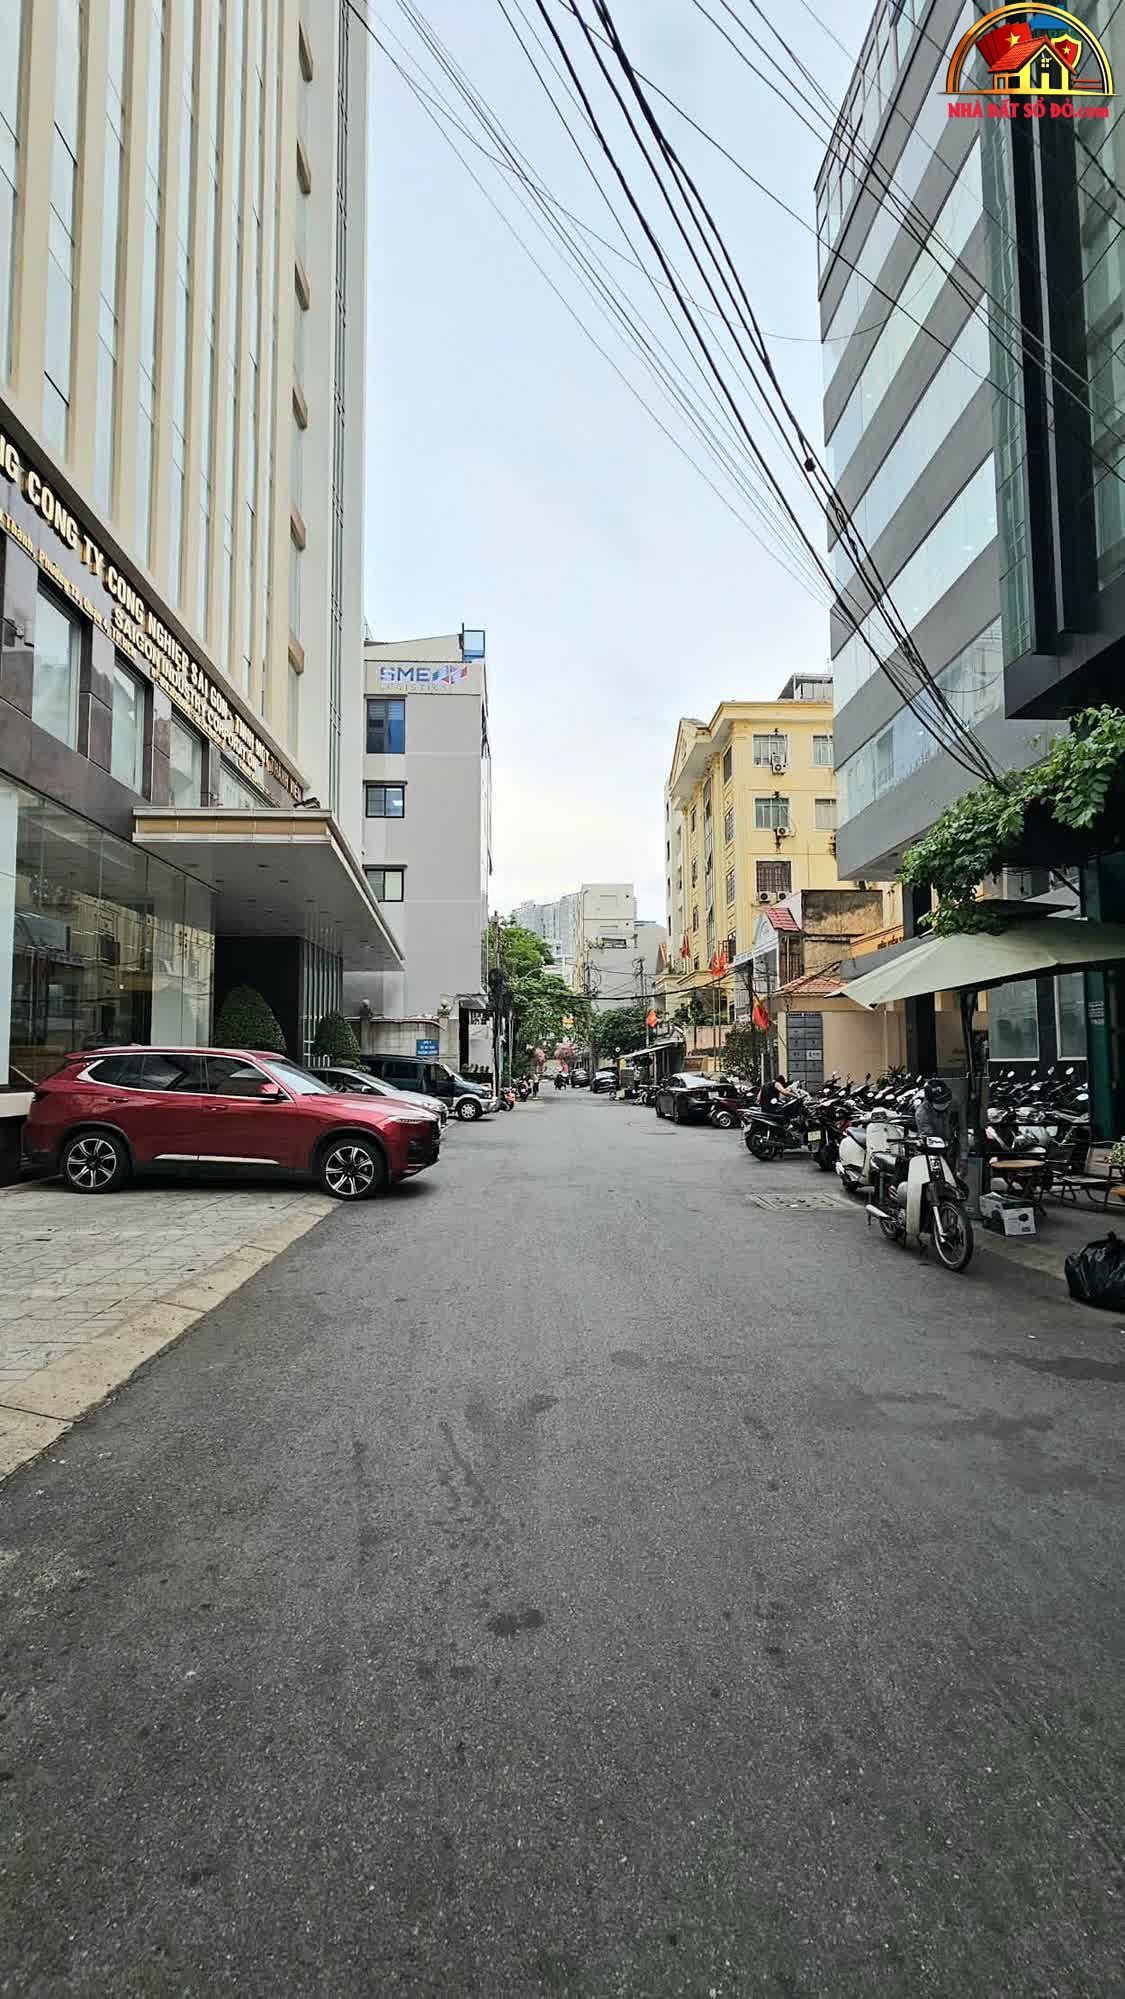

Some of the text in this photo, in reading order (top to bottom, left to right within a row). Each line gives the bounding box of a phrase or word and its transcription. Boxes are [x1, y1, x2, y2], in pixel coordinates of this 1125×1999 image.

[83, 534, 105, 576] TY
[114, 607, 161, 669] SAIGON
[161, 657, 206, 718] INDUSTRY
[379, 666, 431, 682] SME
